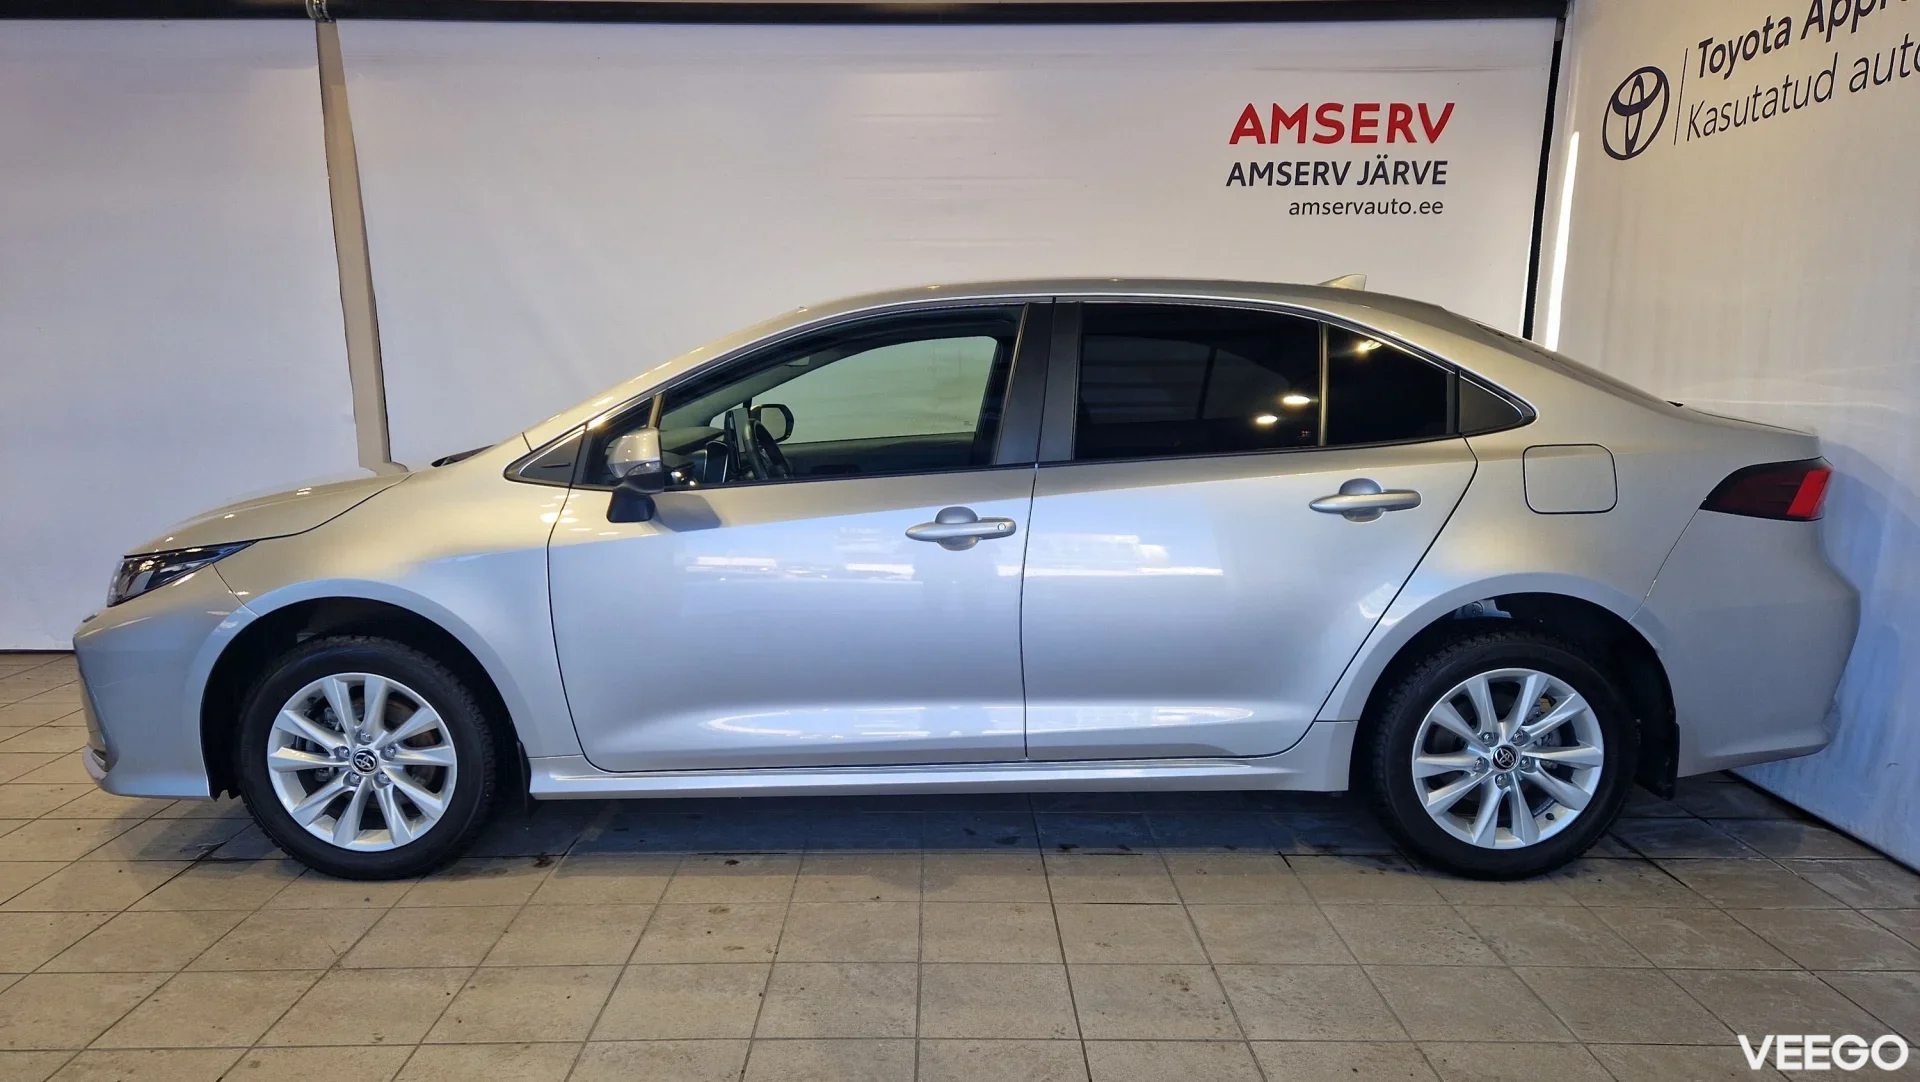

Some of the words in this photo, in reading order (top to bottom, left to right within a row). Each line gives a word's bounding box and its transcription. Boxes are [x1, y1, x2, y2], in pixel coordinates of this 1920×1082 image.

[1698, 15, 1792, 80] Toyota
[1800, 0, 1909, 43] App
[1686, 52, 1838, 142] Kasutatud
[1228, 102, 1456, 145] AMSERV
[1225, 160, 1352, 187] AMSERV
[1356, 153, 1448, 186] JÄRVE
[1288, 198, 1444, 216] amservauto.ee
